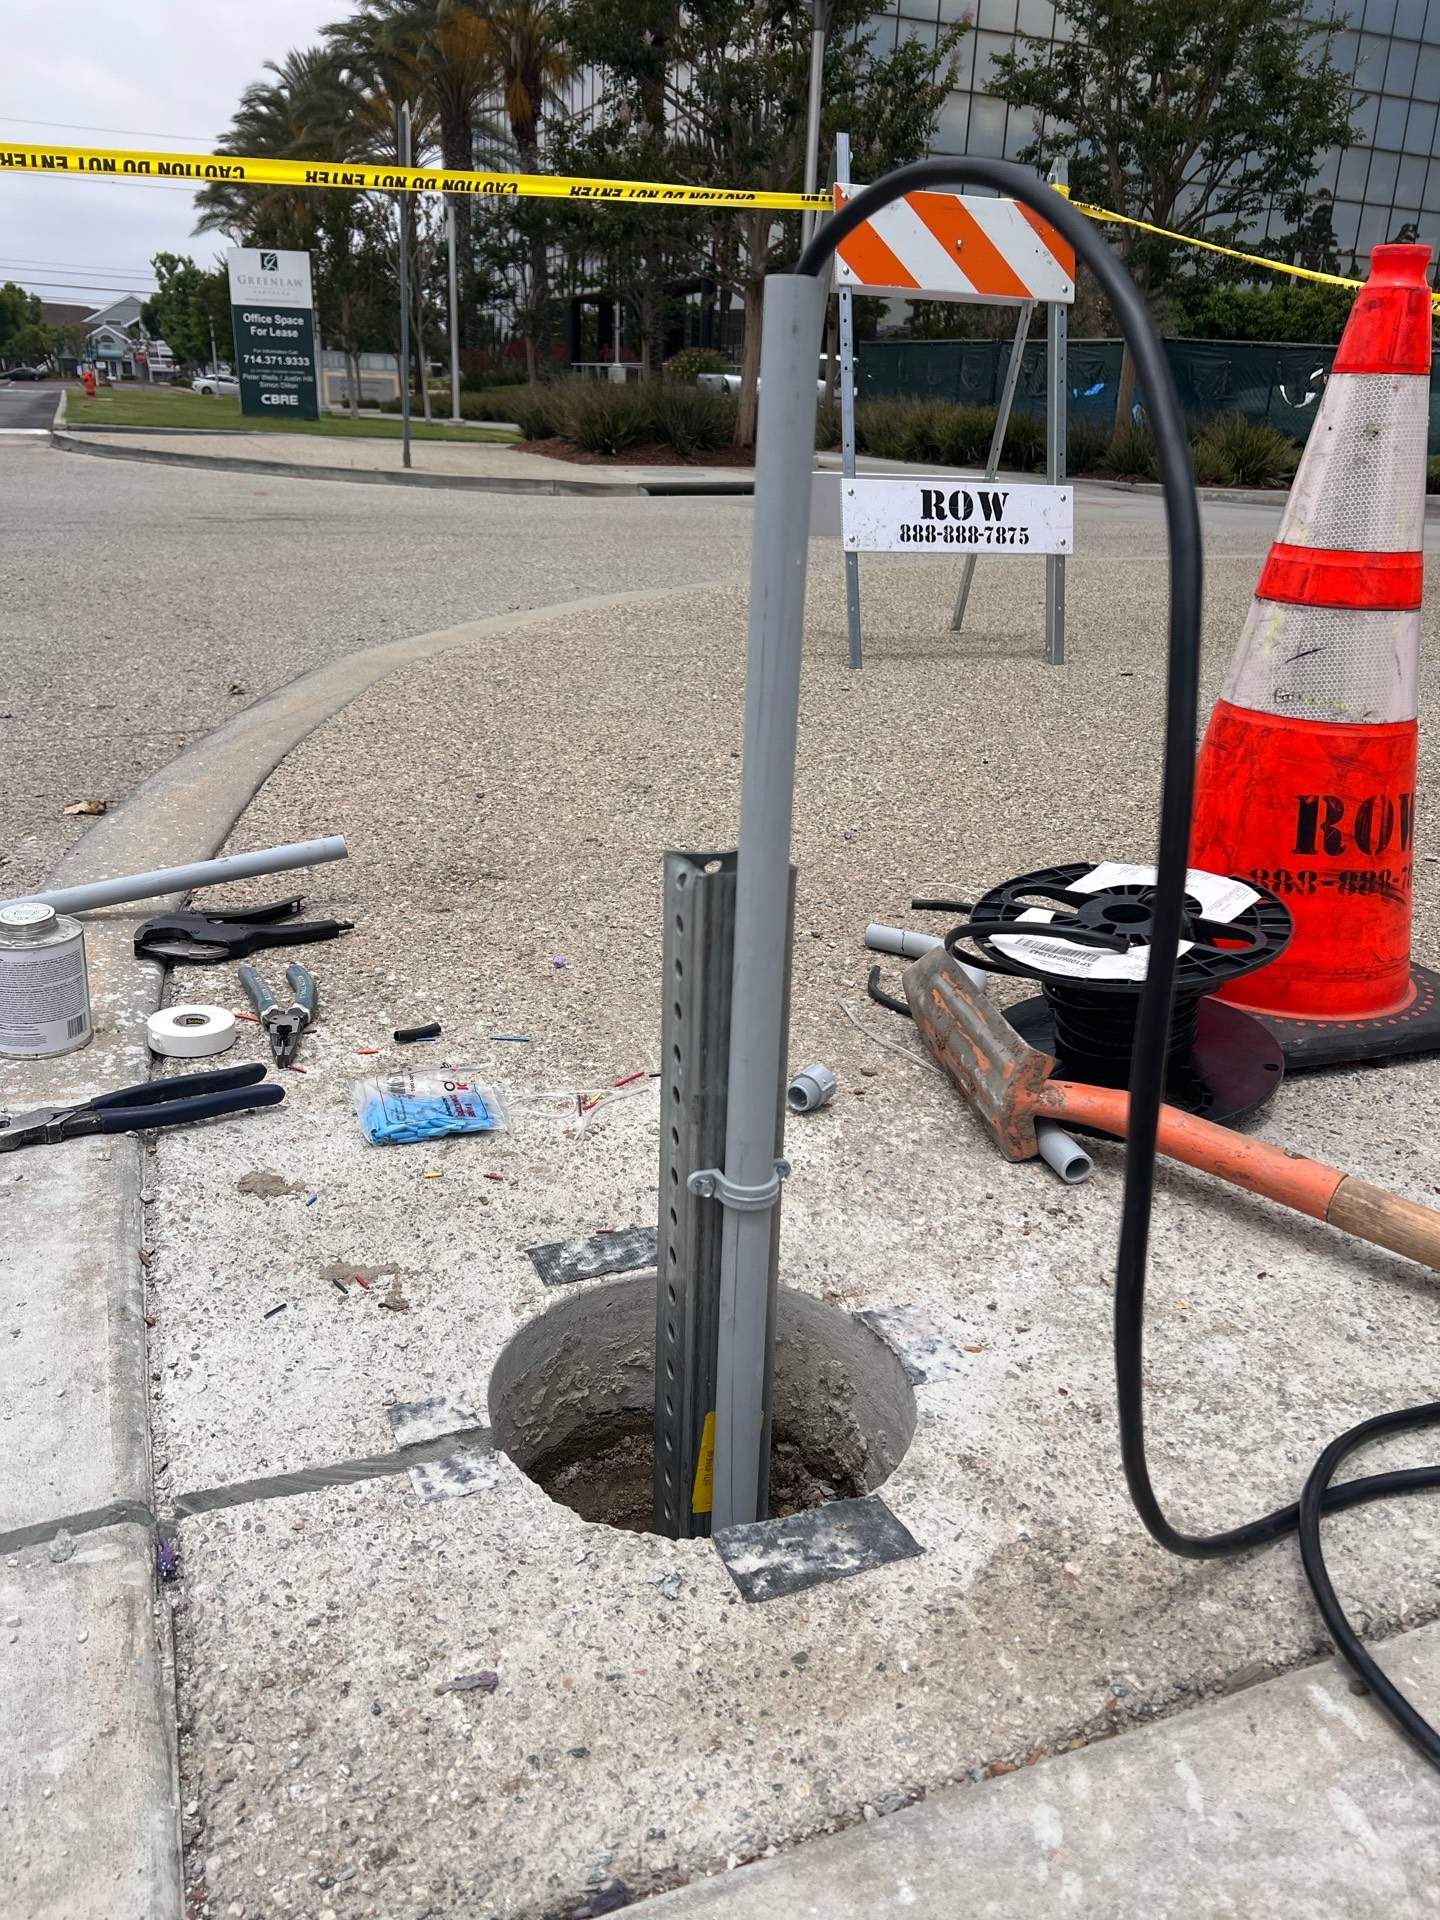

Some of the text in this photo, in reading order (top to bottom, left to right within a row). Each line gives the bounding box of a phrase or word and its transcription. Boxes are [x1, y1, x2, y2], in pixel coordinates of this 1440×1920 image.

[78, 156, 116, 172] NOT
[123, 159, 151, 174] DO
[158, 161, 245, 179] CAUTION
[305, 170, 518, 194] CAUTION DO NOT ENTER
[242, 313, 304, 326] Office Space
[250, 326, 299, 338] For Lease
[243, 354, 310, 366] 714.371.9333
[260, 394, 299, 405] CBRE
[920, 489, 1010, 521] ROW
[899, 523, 1030, 545] 888-888-7875
